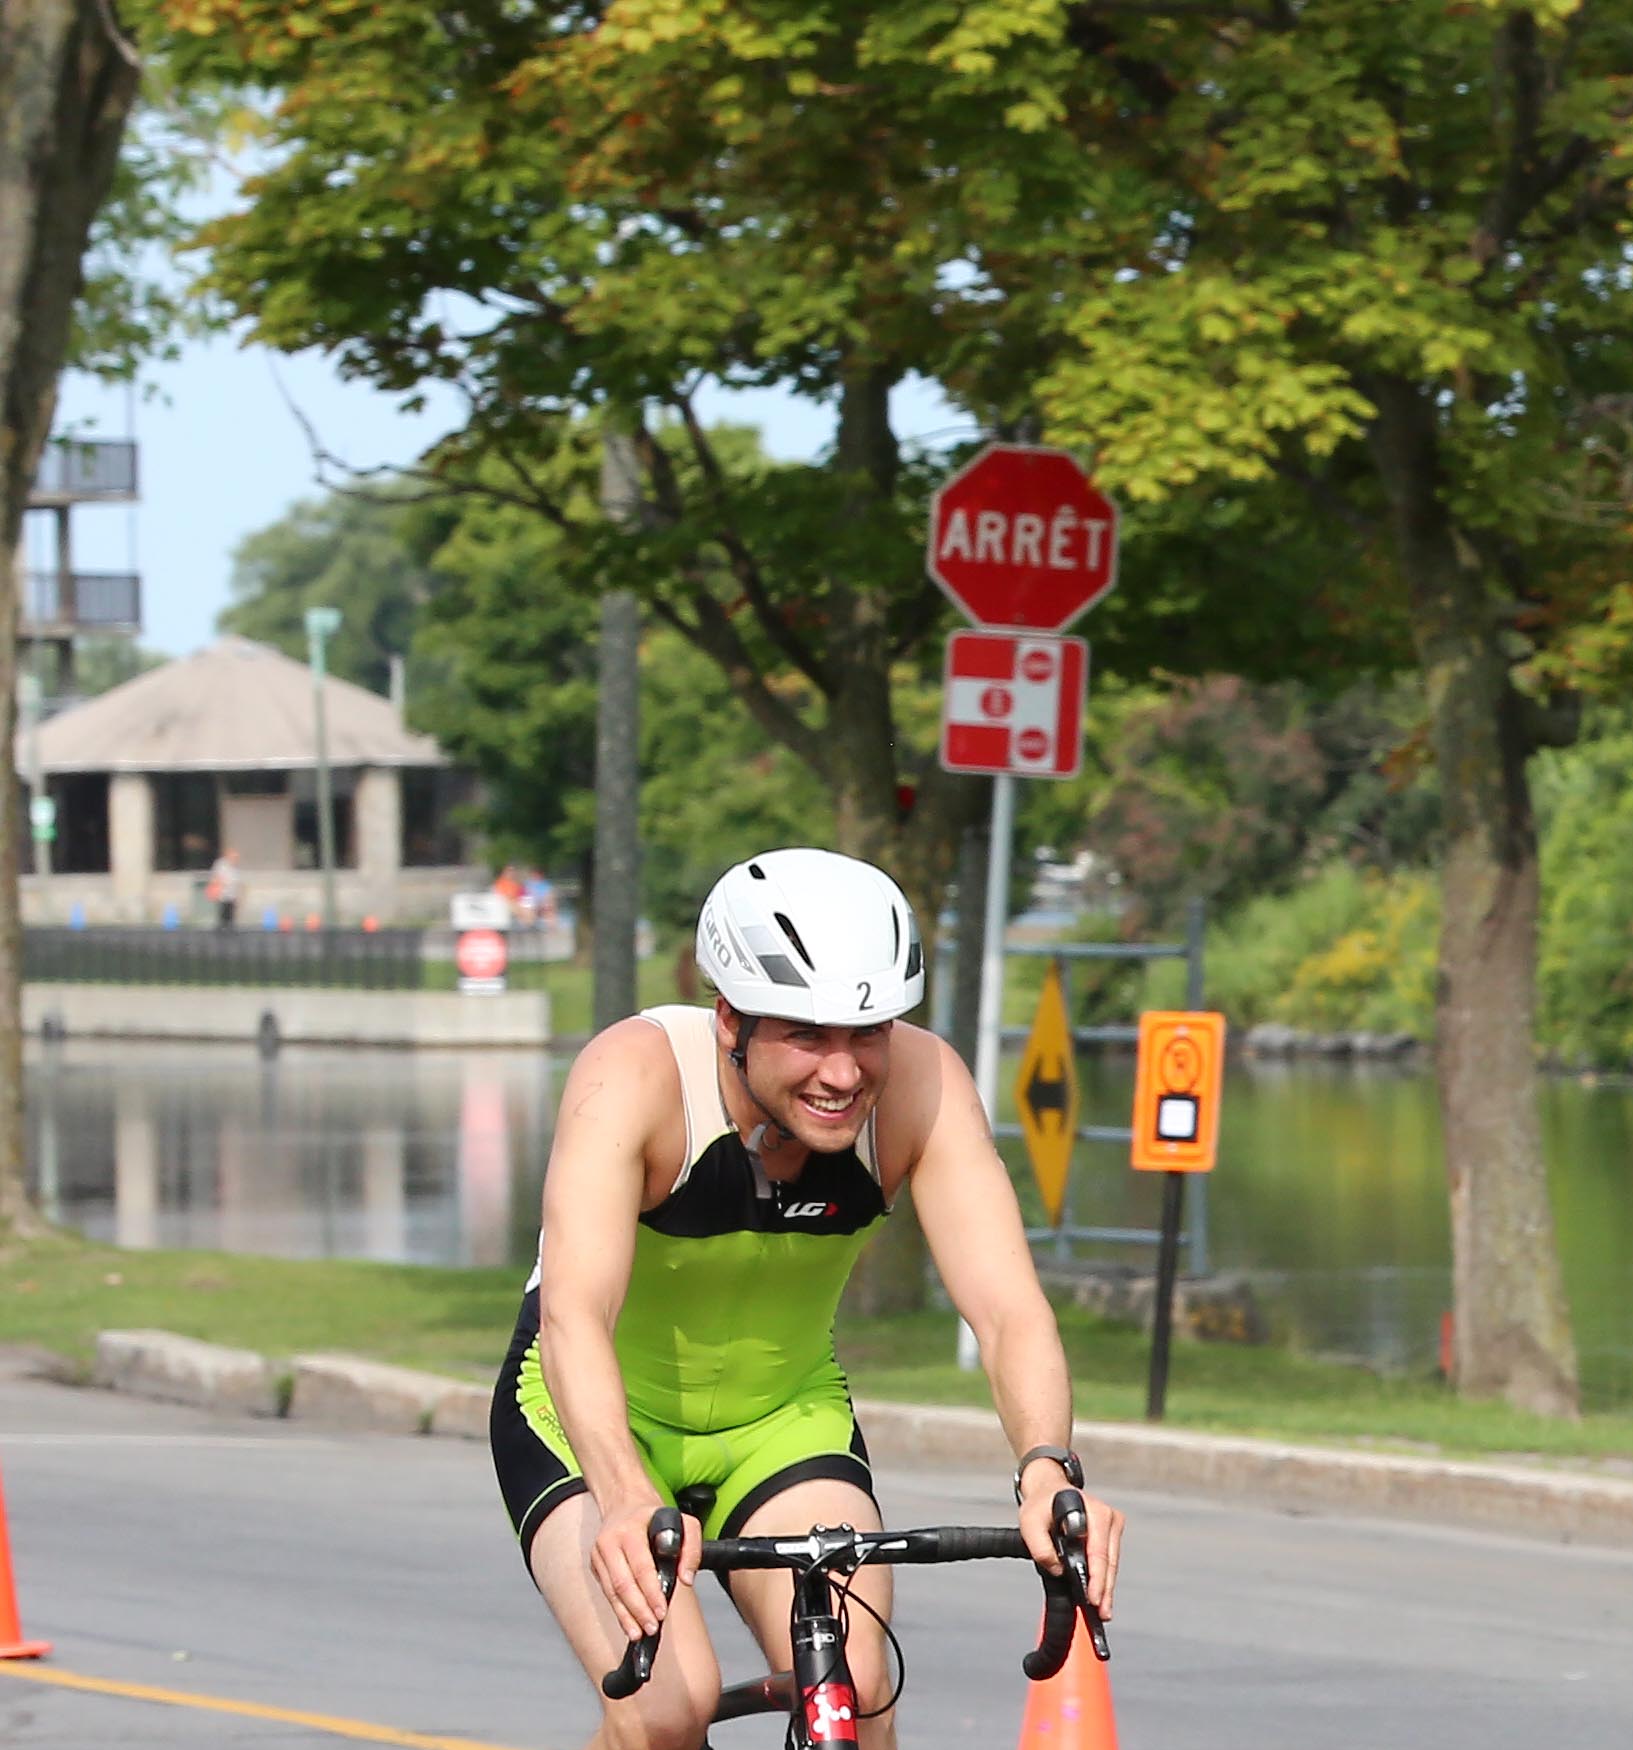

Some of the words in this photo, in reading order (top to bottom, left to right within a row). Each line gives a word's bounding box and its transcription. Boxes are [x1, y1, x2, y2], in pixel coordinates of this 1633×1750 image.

[941, 504, 1107, 572] ARRÊT
[705, 906, 732, 968] GIRO
[856, 981, 874, 1011] 2
